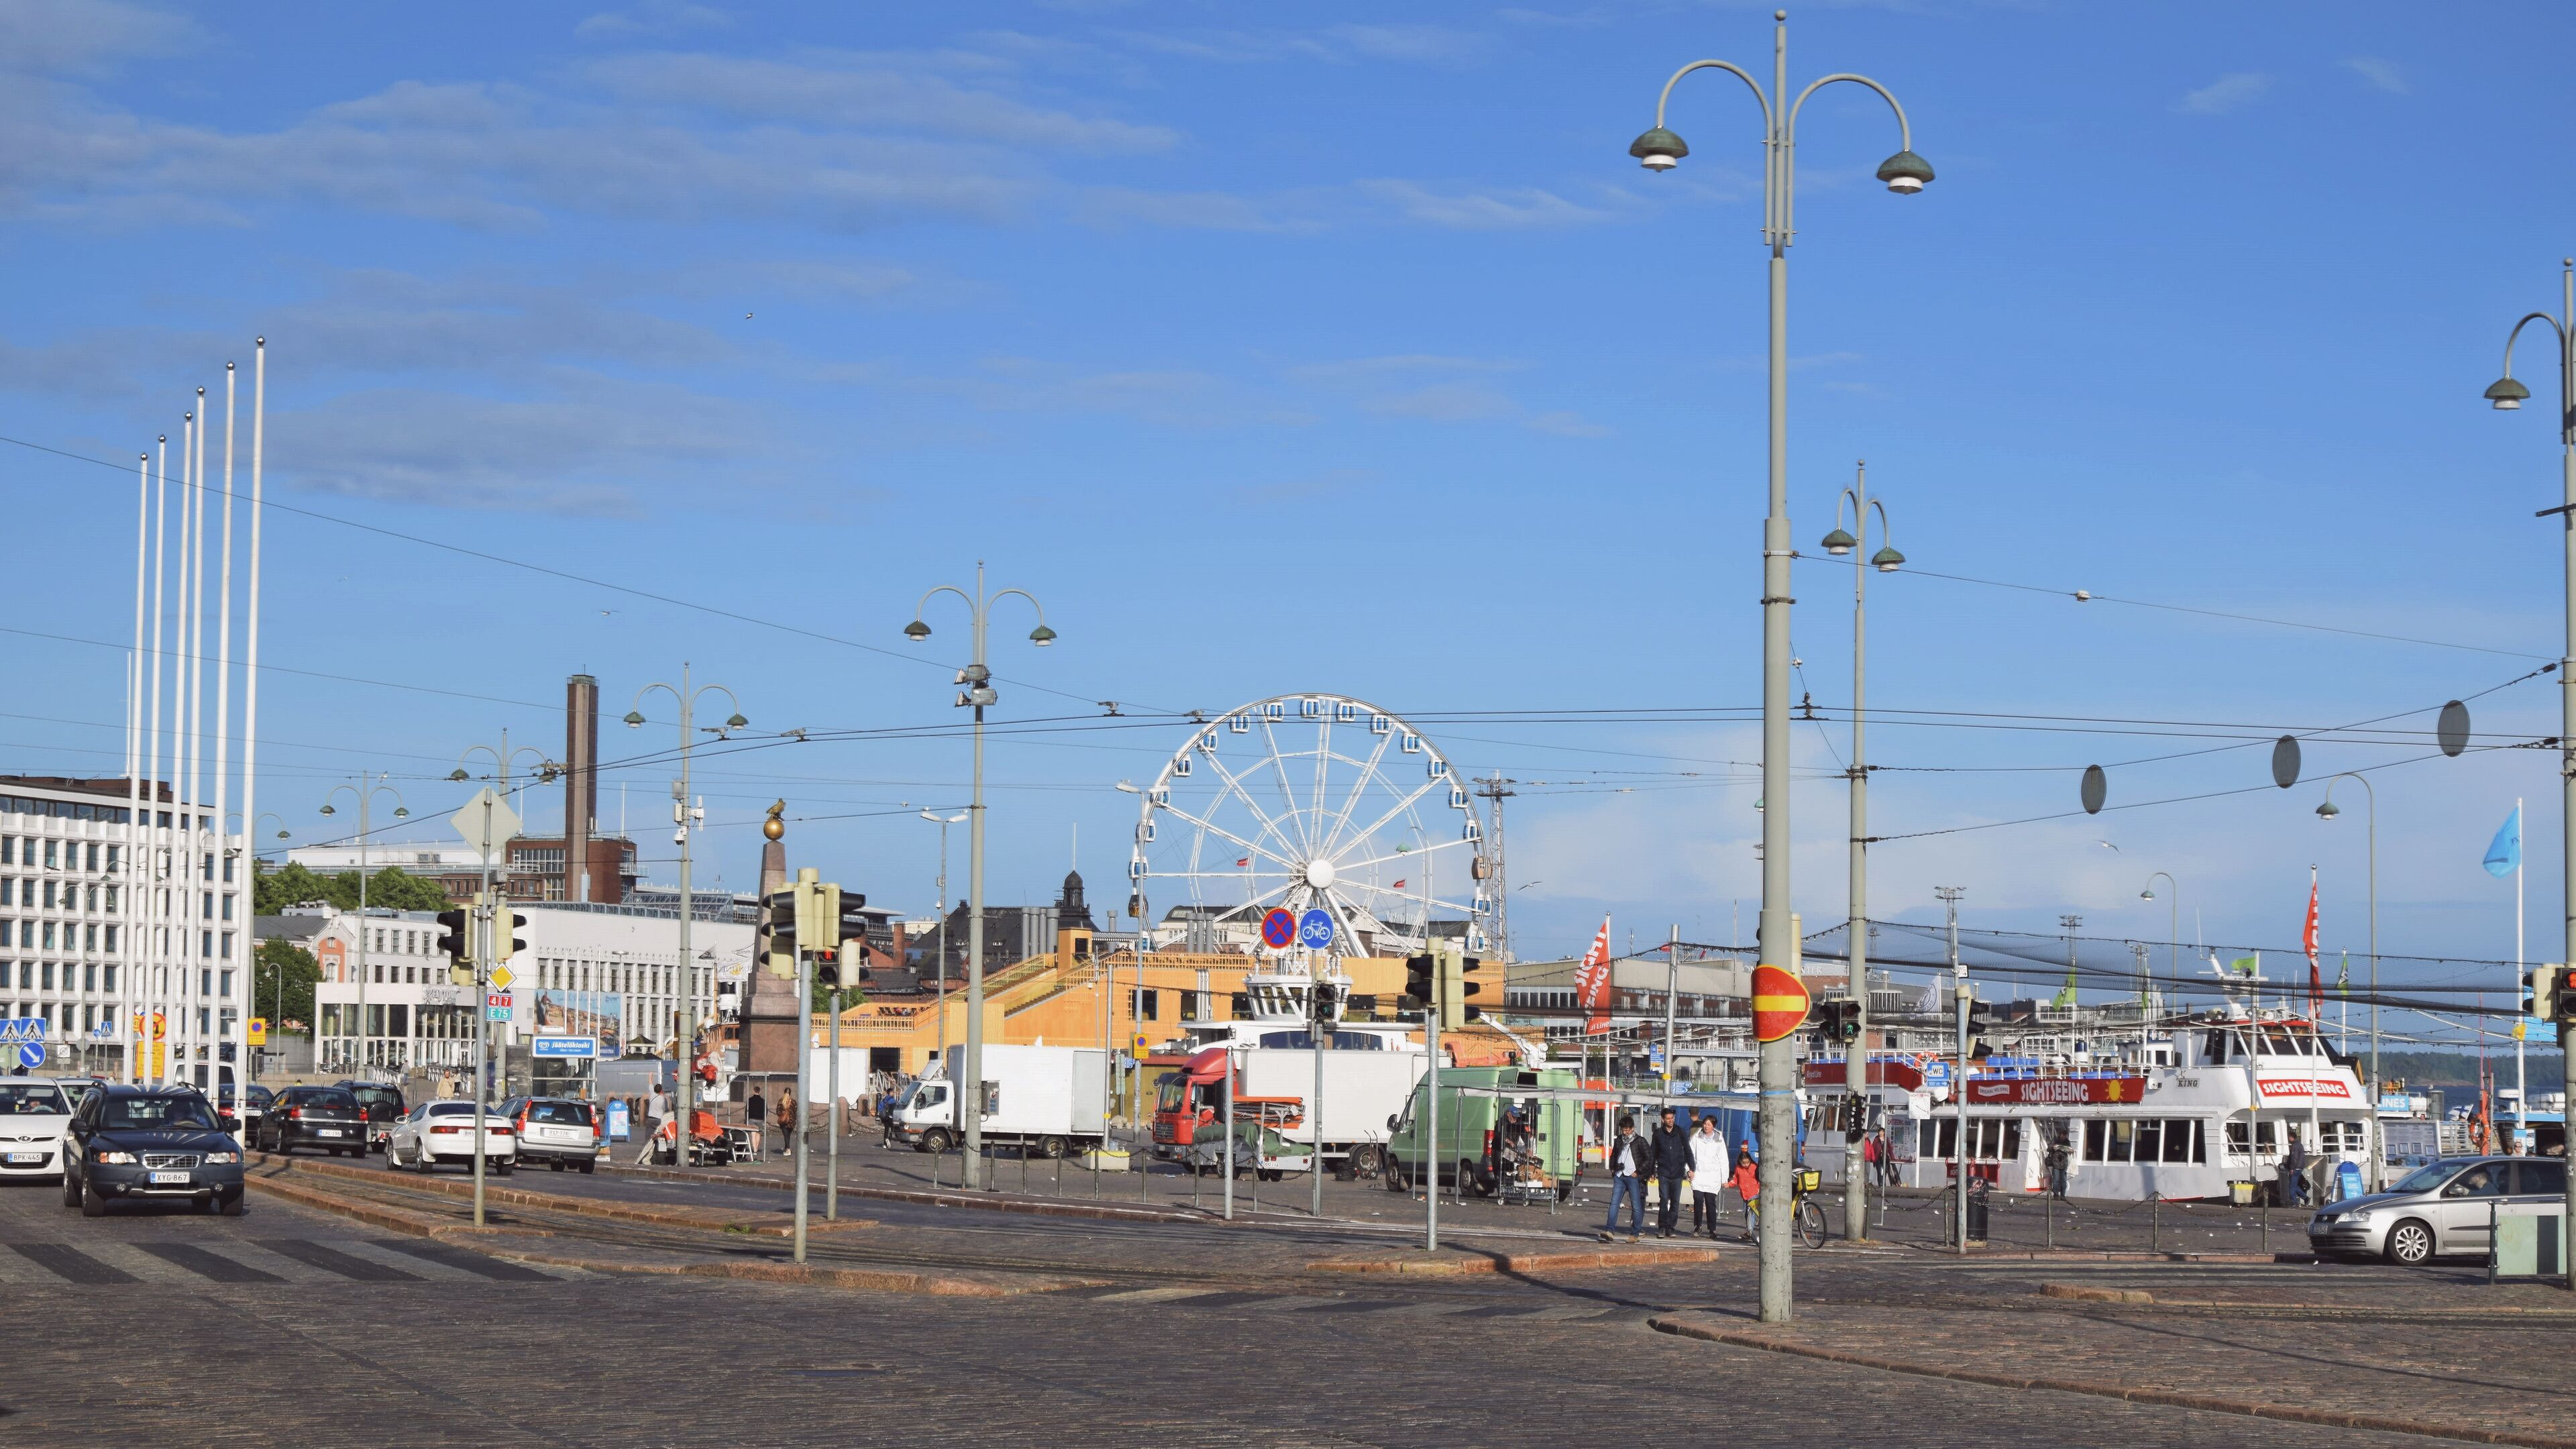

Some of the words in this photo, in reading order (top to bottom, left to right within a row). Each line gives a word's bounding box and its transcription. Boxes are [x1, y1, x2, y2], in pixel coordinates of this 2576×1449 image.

[490, 998, 496, 1006] 4
[504, 998, 508, 1006] 7
[490, 1010, 496, 1018] E
[498, 1010, 508, 1018] 75
[2021, 1081, 2089, 1102] SIGHTSEEING
[2263, 1081, 2347, 1095] SIGHTSEEING
